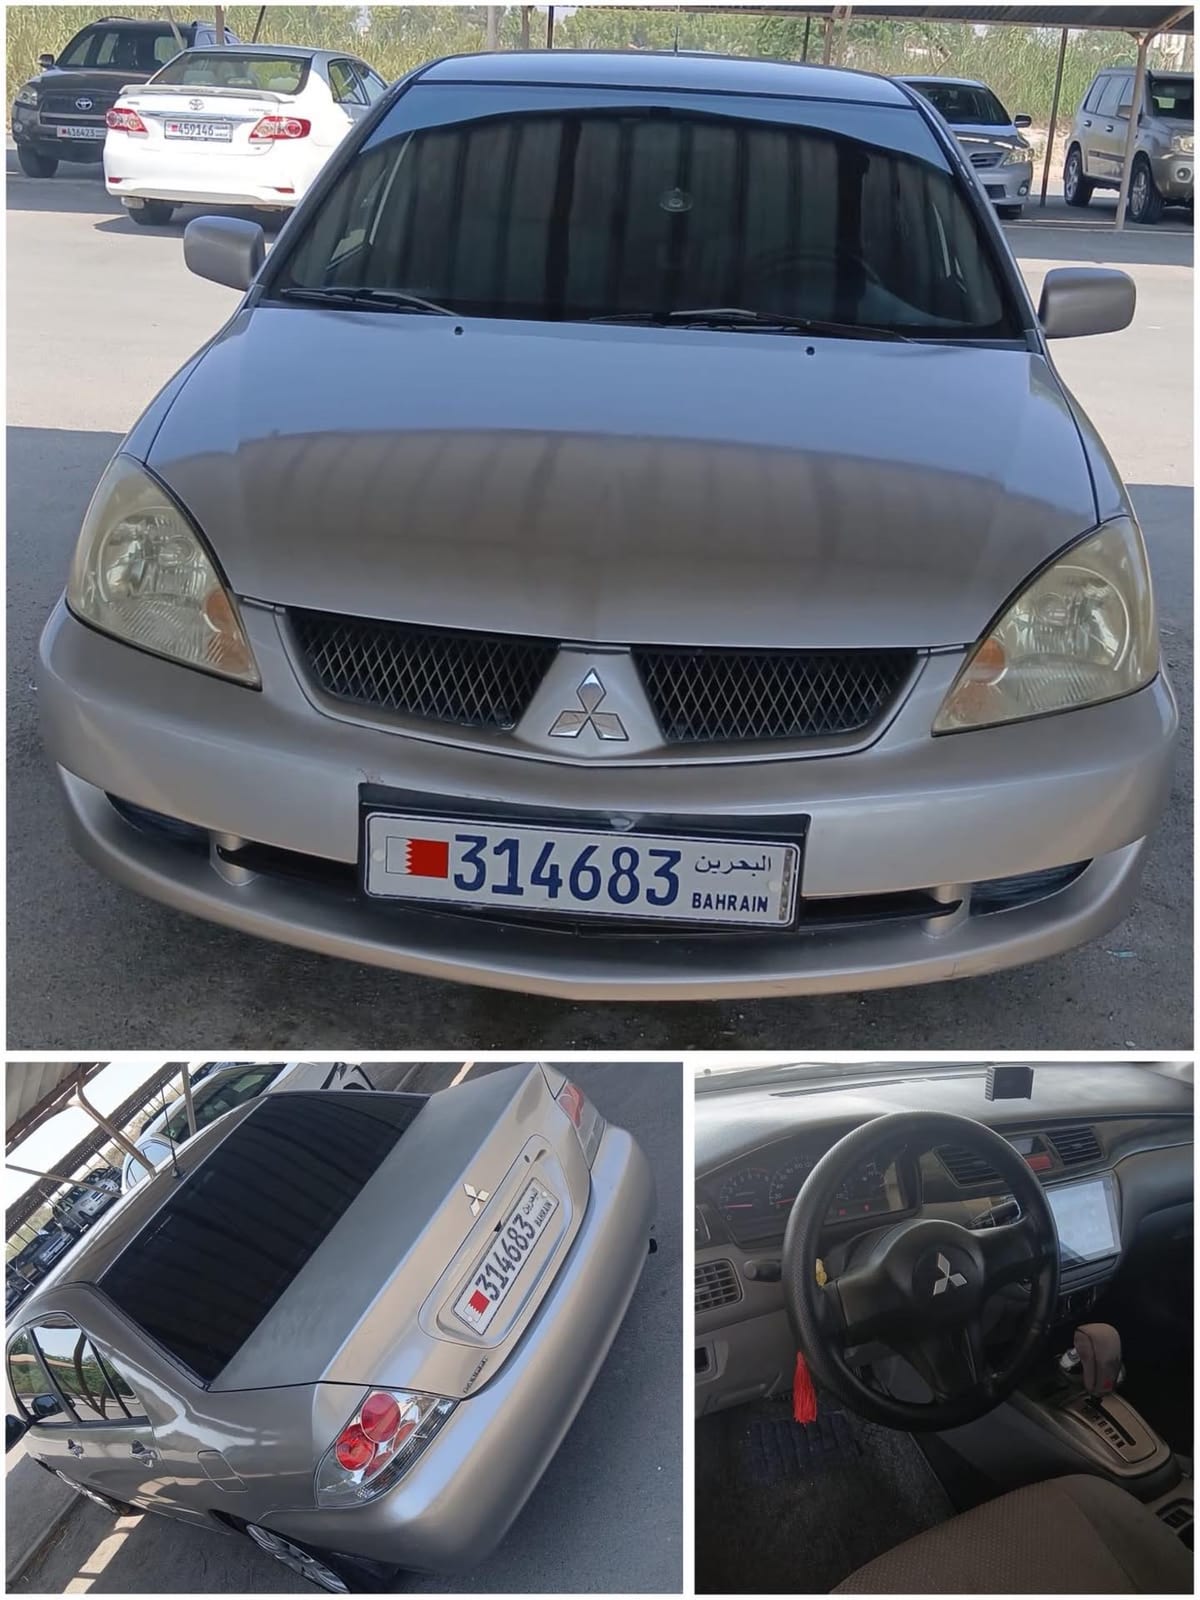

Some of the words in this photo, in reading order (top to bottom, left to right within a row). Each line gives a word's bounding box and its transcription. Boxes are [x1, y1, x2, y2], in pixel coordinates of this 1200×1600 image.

[179, 123, 214, 136] 459146
[453, 834, 682, 906] 314683
[694, 855, 772, 877] البحرين
[691, 892, 768, 913] BAHRAIN
[534, 1201, 553, 1228] BAHRAIN
[475, 1213, 536, 1301] 314683
